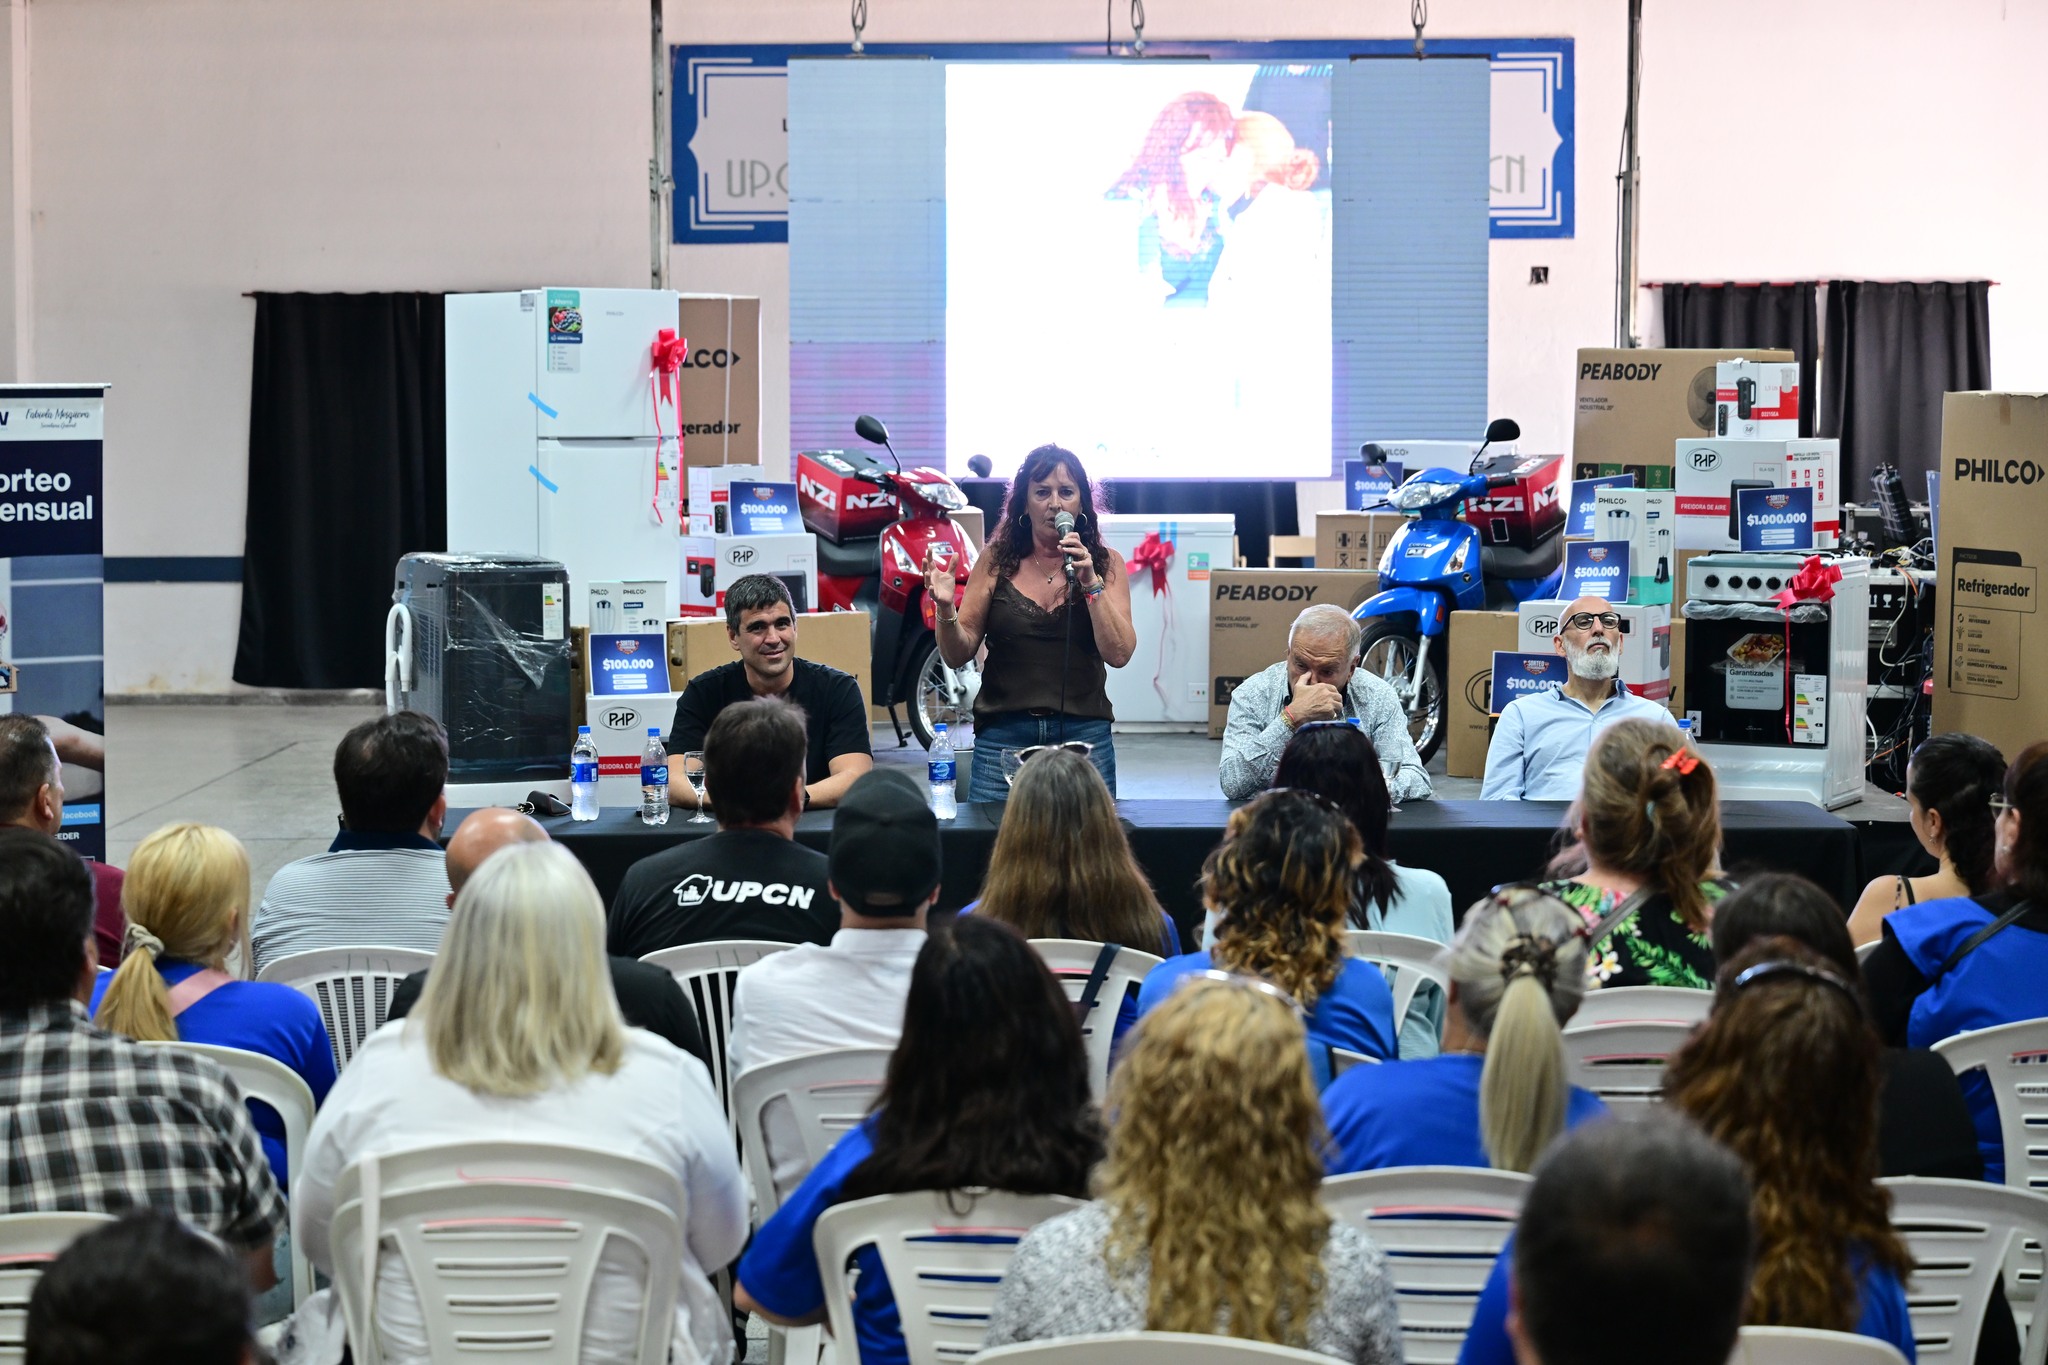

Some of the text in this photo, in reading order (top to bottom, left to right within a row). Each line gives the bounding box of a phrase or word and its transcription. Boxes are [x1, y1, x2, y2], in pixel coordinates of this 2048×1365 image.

[1580, 362, 1662, 381] PEABODY
[1693, 453, 1717, 467] PHP
[1955, 458, 2036, 485] PHILCO
[741, 503, 788, 515] $100.000
[1747, 512, 1807, 527] $1.000.000
[733, 550, 754, 562] PHP
[1574, 566, 1620, 579] $500.000
[1215, 585, 1318, 602] PEABODY
[1958, 578, 2030, 598] Refrigerador
[602, 659, 654, 671] $100.000
[1729, 669, 1774, 677] Garantizadas
[609, 713, 634, 726] PHP
[712, 880, 815, 909] UPCN
